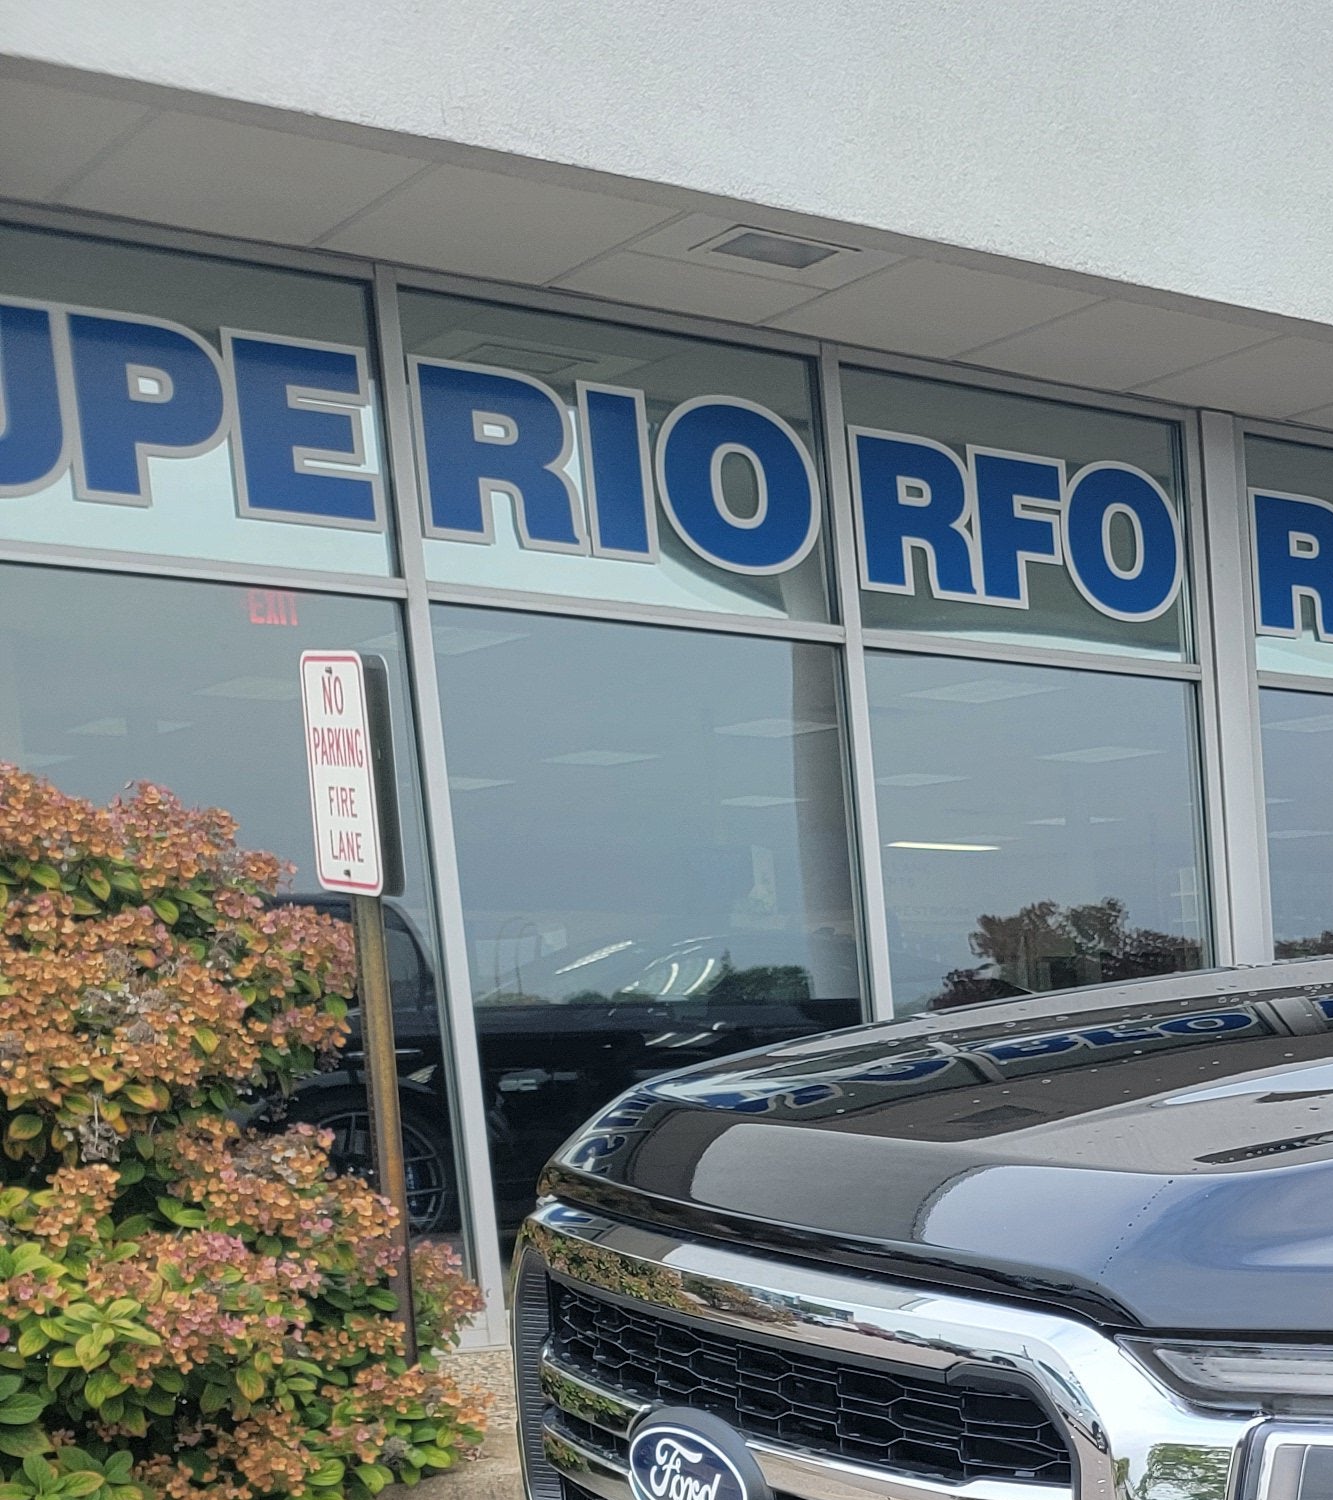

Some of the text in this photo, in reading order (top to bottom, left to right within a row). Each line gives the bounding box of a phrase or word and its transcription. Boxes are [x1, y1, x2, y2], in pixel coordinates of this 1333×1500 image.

[321, 675, 345, 715] NO
[312, 727, 364, 768] PARKING
[328, 786, 358, 818] FIRE
[330, 829, 365, 863] LANE
